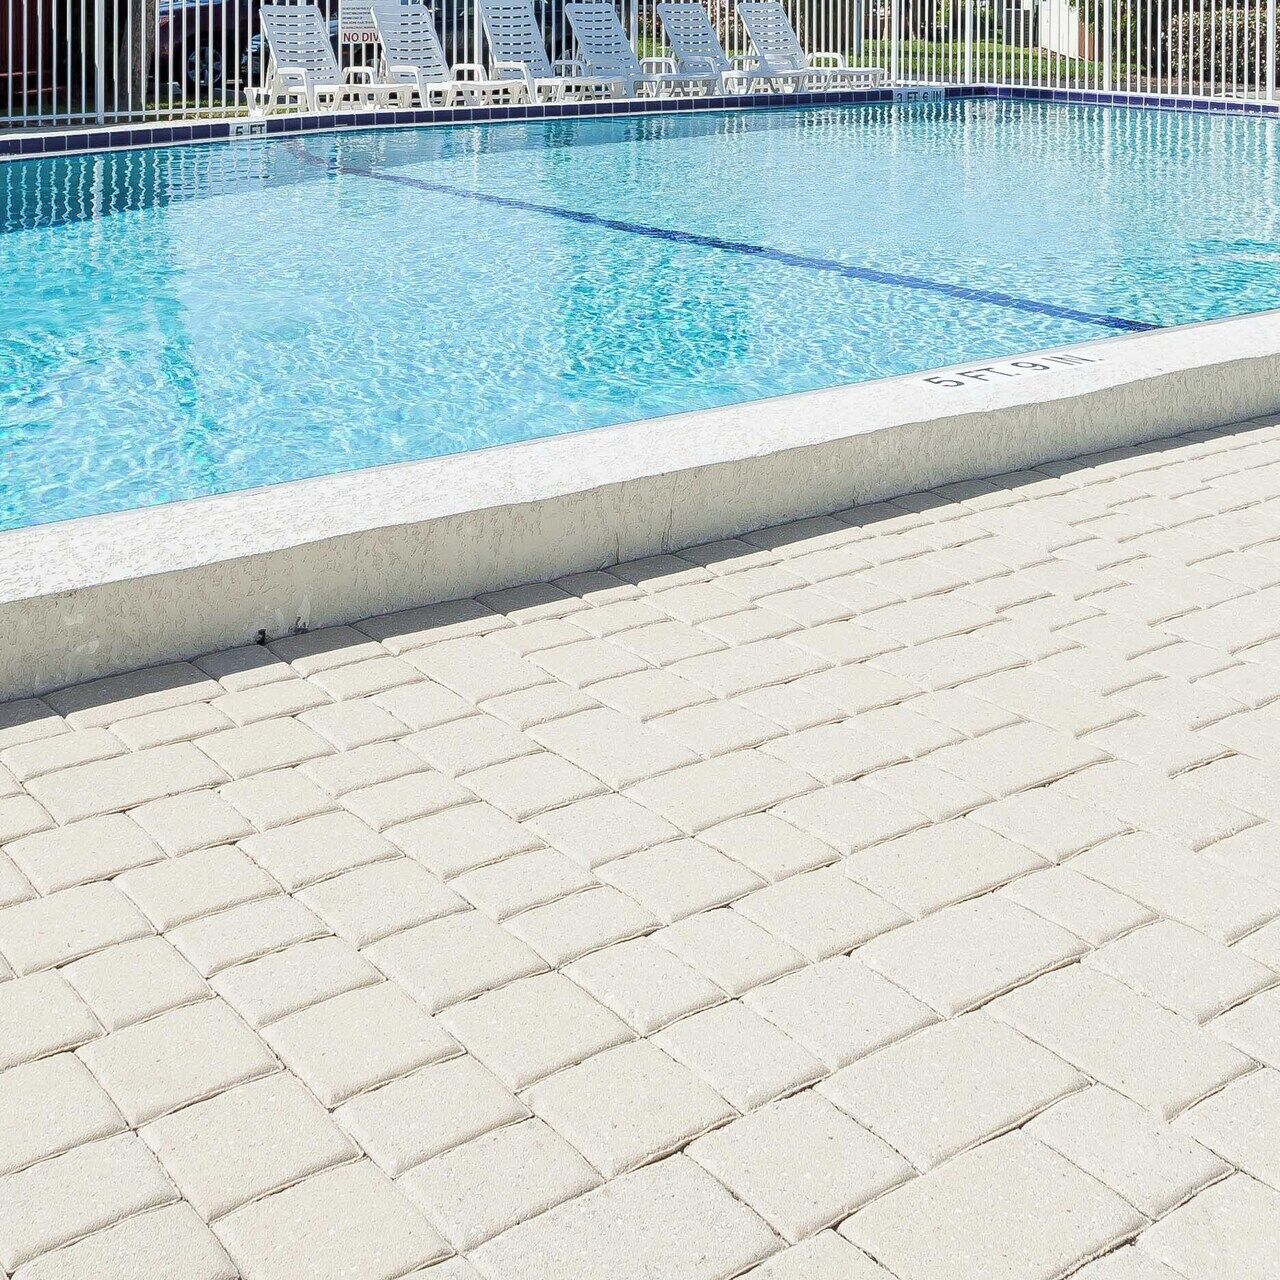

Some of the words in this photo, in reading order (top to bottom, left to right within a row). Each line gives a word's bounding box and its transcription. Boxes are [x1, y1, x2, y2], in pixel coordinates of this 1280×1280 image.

[343, 32, 359, 42] NO
[361, 32, 379, 42] DIV
[896, 93, 903, 103] 3
[907, 91, 918, 103] FT
[932, 91, 942, 102] IN
[235, 125, 243, 136] 5
[250, 124, 265, 135] FT
[923, 376, 965, 388] 5
[1011, 361, 1051, 371] 9
